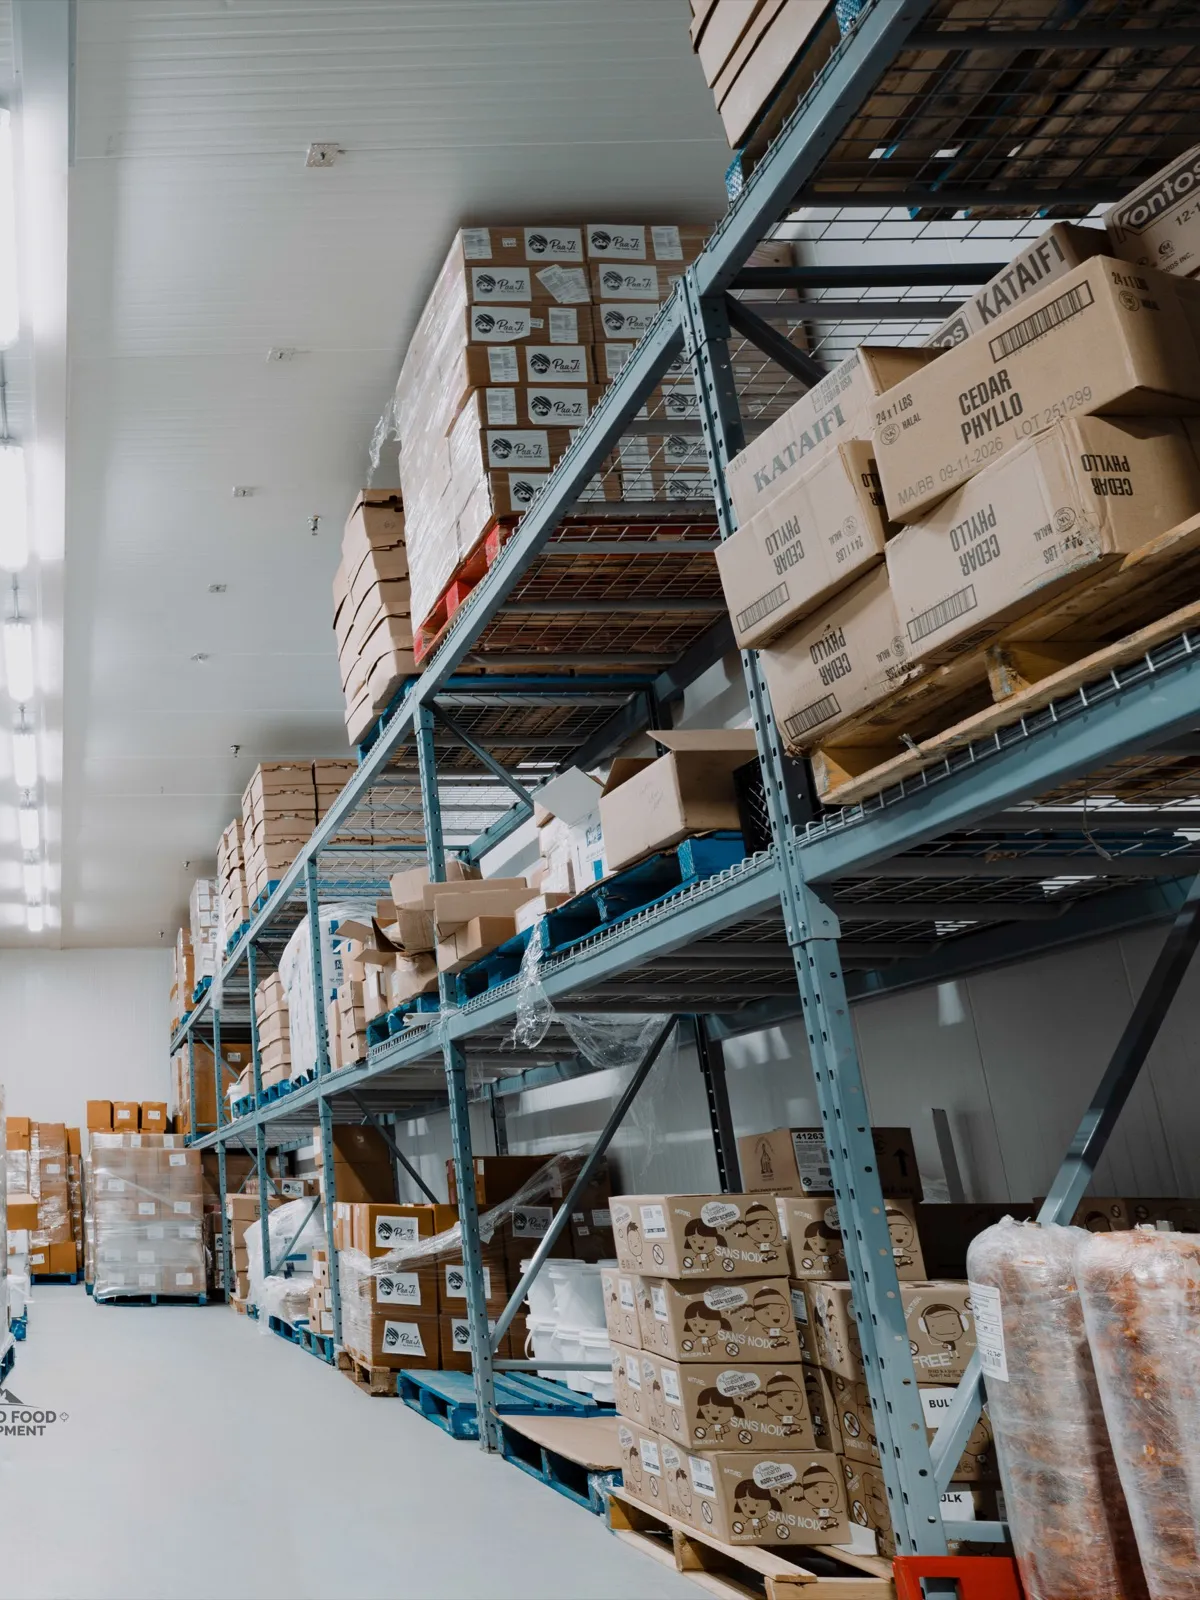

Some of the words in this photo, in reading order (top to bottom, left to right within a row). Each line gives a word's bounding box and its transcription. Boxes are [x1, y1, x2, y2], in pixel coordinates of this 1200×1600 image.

[976, 235, 1066, 326] KATAIFI
[875, 411, 887, 426] 24
[893, 403, 899, 416] 1
[899, 393, 914, 411] LBS
[958, 369, 1013, 416] CEDAR
[902, 412, 922, 430] HALAL
[939, 437, 1004, 482] 09-11-2026
[1012, 415, 1041, 441] LOT
[1044, 385, 1093, 423] 251299
[960, 392, 1024, 445] PHYLLO
[752, 403, 848, 494] KATAIFI
[1081, 454, 1131, 473] PHYLLO
[1090, 477, 1134, 496] CEDAR
[765, 515, 801, 556] PHYLLO
[950, 503, 998, 552] PHYLLO
[773, 540, 805, 576] CEDAR
[958, 533, 1001, 577] CEDAR
[810, 625, 847, 665] PHYLLO
[818, 652, 853, 687] CEDAR
[714, 1246, 740, 1259] SANS
[741, 1250, 765, 1264] NOIX
[717, 1330, 746, 1344] SANS
[748, 1335, 774, 1349] NOIX
[929, 1399, 953, 1408] BUL
[730, 1417, 759, 1432] SANS
[760, 1422, 786, 1437] NOIX
[940, 1494, 962, 1503] ULK
[767, 1510, 796, 1526] SANS
[797, 1516, 822, 1531] NOIX
